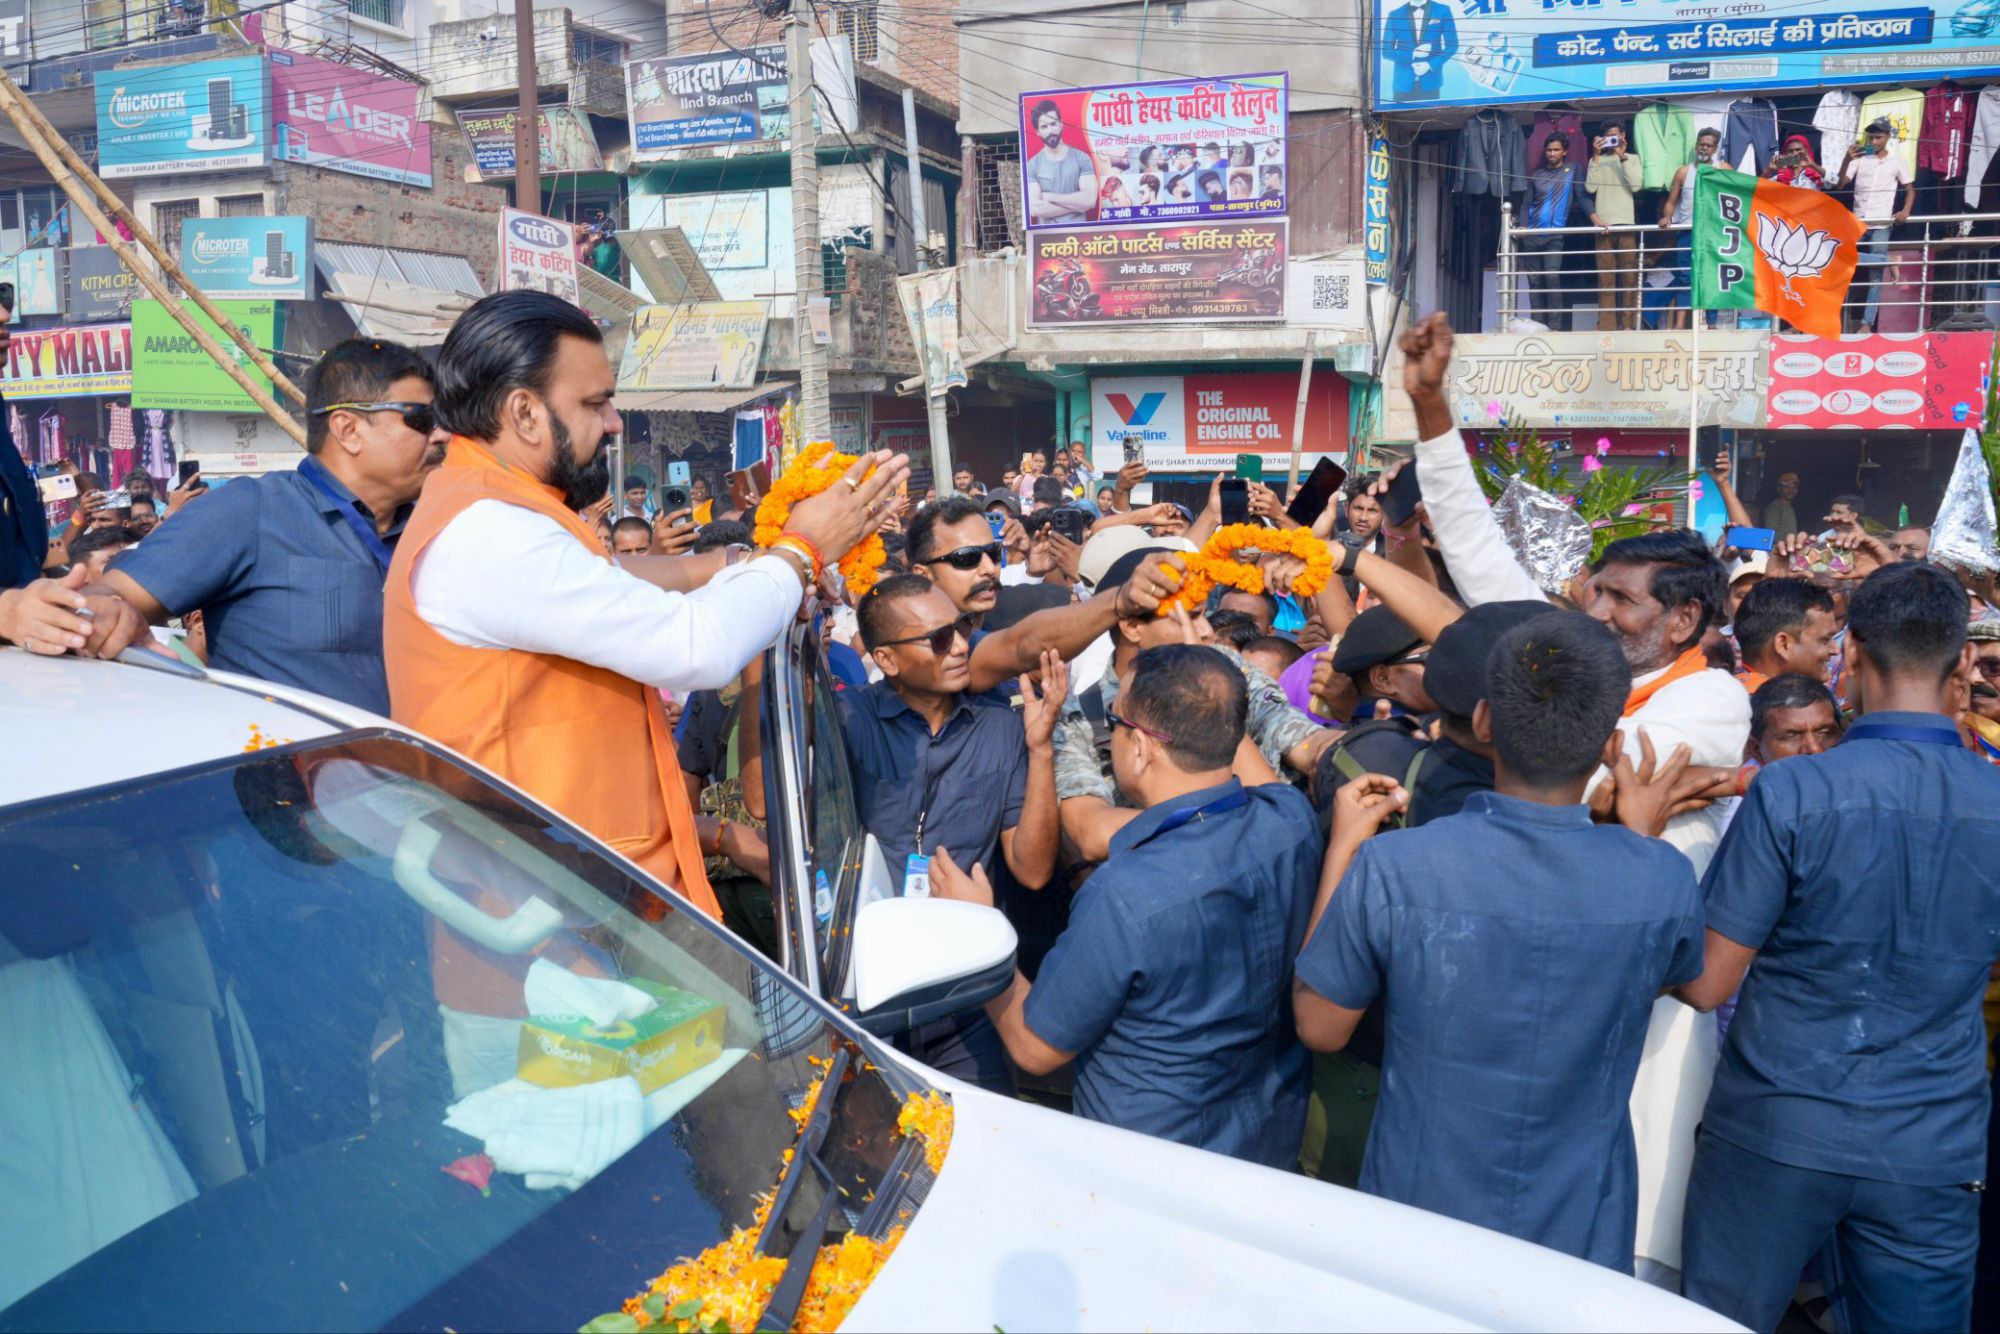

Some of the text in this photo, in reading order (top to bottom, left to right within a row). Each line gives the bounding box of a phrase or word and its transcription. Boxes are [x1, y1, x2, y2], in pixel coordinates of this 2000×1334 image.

[1557, 14, 1914, 57] कोट, पैन्ट, सर्ट सिलाई की प्रतिष्ठान
[665, 60, 722, 95] शारदा
[117, 91, 187, 113] MICROTEK
[708, 91, 754, 107] Branch
[1091, 91, 1133, 127] गांधी
[1136, 91, 1173, 123] हेयर
[1175, 84, 1227, 121] कटिंग
[287, 84, 413, 149] LEADER
[157, 162, 185, 171] BATTERY
[516, 219, 560, 246] गांधी
[1041, 236, 1080, 258] लकी
[1082, 234, 1118, 256] ऑटो
[1182, 229, 1232, 250] सर्विस
[1235, 230, 1276, 250] सेंटर
[198, 238, 249, 251] MICROTEK
[509, 241, 573, 275] हेयर कटिंग
[1120, 262, 1137, 275] मेन
[1159, 262, 1192, 276] तारापुर
[81, 276, 111, 291] KITMI
[3, 334, 43, 379] TY
[1456, 337, 1598, 397] साहिल
[1197, 391, 1223, 406] THE
[1197, 407, 1271, 423] ORIGINAL
[1197, 424, 1282, 440] ENGINE OIL
[1146, 459, 1164, 467] SHIV
[1166, 458, 1195, 467] SHAKTI
